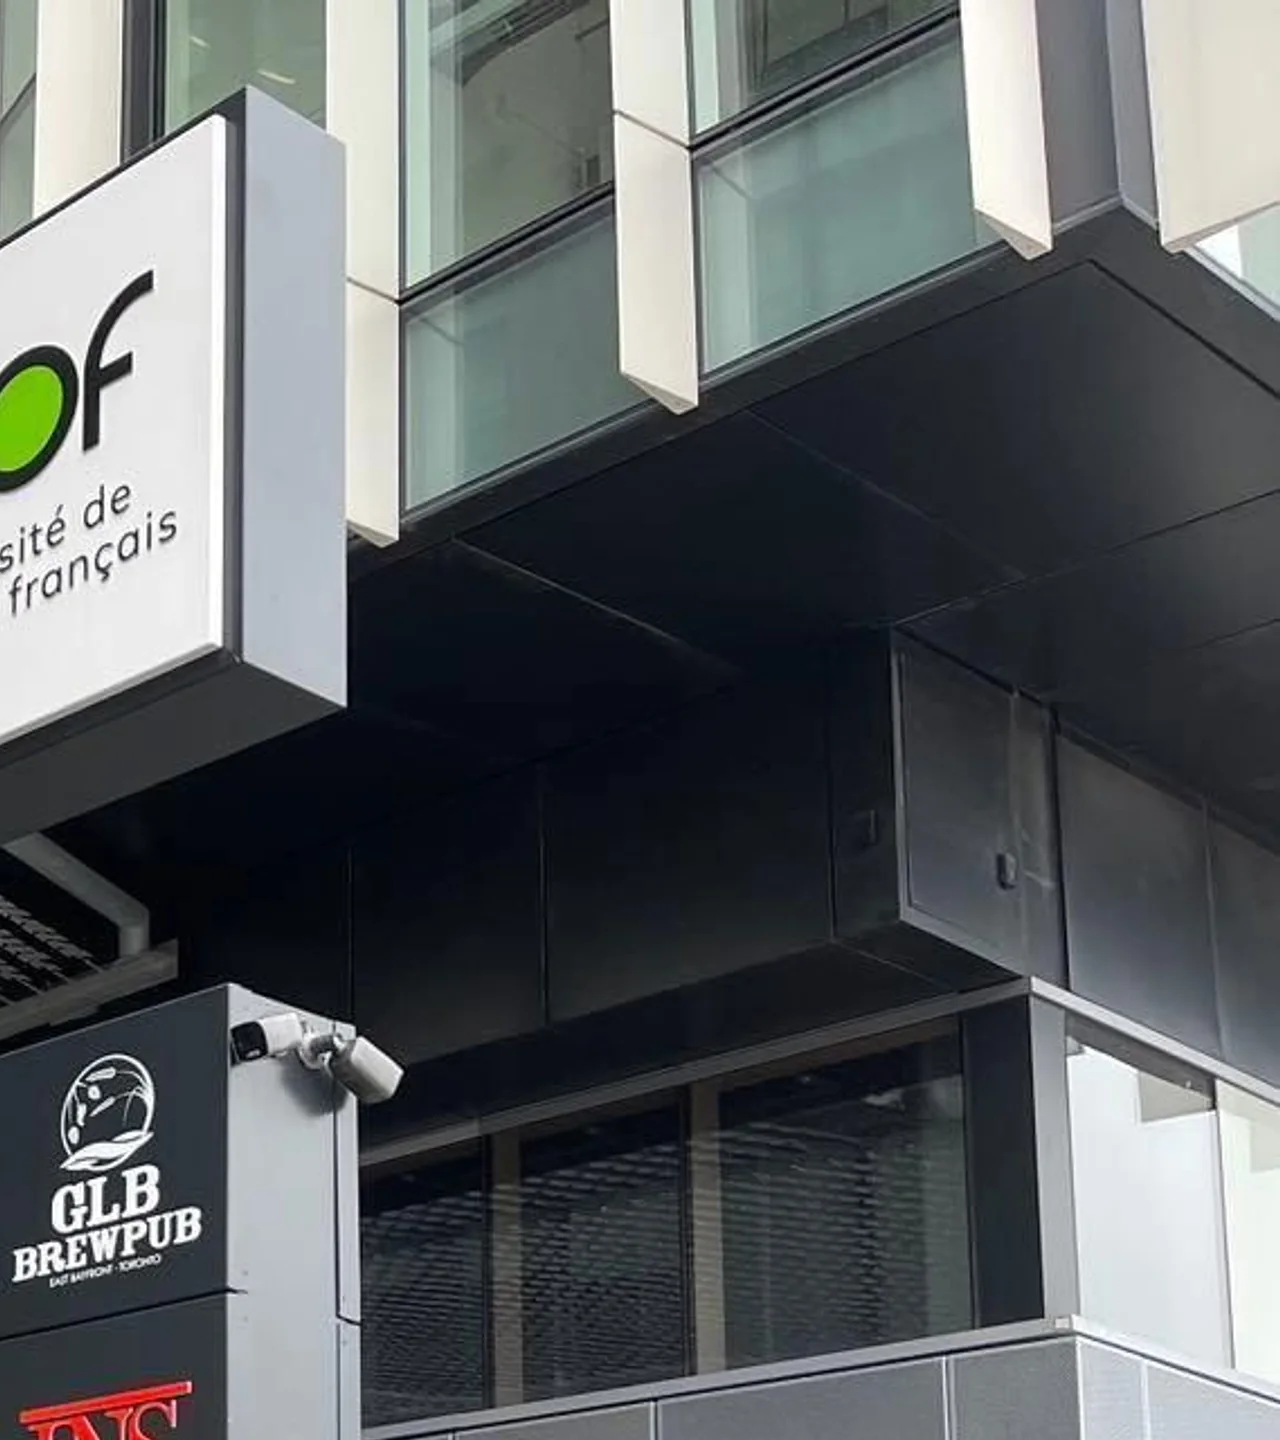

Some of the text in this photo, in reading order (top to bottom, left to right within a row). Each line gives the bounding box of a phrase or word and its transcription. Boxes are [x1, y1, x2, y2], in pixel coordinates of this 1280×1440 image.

[83, 484, 132, 529] de
[8, 510, 177, 618] français
[51, 1164, 160, 1234] GLB
[12, 1206, 202, 1283] BREWPUB
